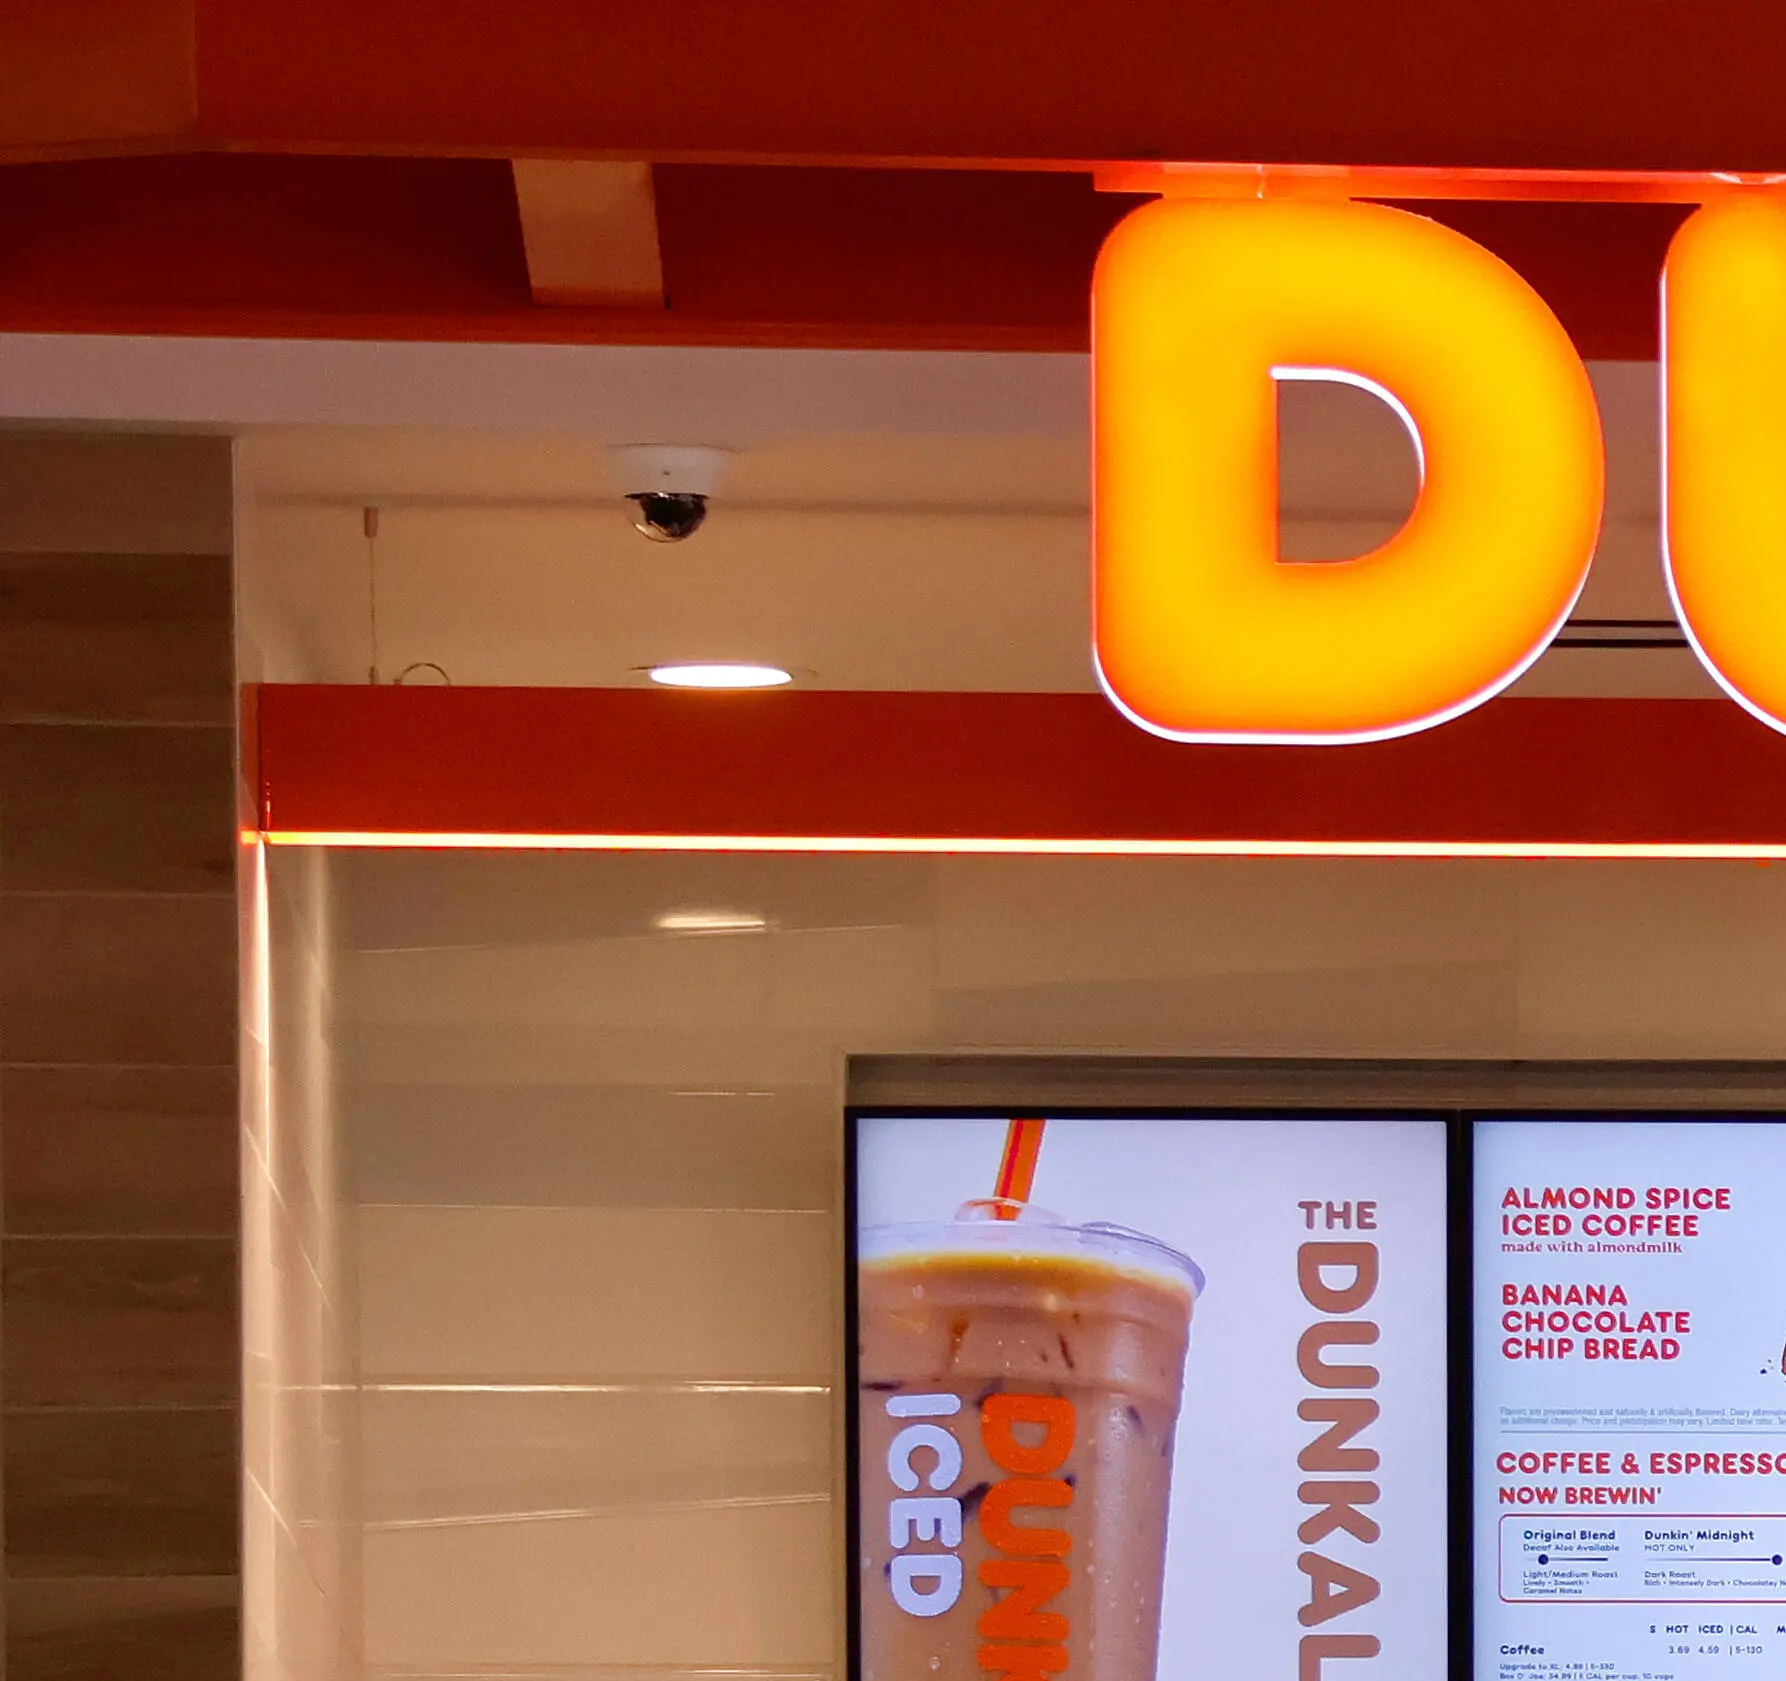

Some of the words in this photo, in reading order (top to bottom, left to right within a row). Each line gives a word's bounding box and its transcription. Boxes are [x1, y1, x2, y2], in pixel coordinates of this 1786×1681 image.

[1502, 1188, 1637, 1211] ALMOND
[1646, 1188, 1732, 1211] SPICE
[1298, 1201, 1379, 1231] THE
[1503, 1212, 1573, 1237] ICED
[1582, 1212, 1700, 1238] COFFEE
[1502, 1242, 1541, 1253] made
[1548, 1241, 1584, 1254] with
[1589, 1242, 1683, 1254] almondmilk
[1503, 1285, 1629, 1307] BANANA
[1502, 1308, 1691, 1334] CHOCOLATE
[1502, 1338, 1575, 1361] CHIP
[1585, 1339, 1681, 1361] BREAD
[1497, 1452, 1612, 1475] COFFEE
[1621, 1453, 1641, 1476] &
[884, 1389, 968, 1622] ICED
[1500, 1487, 1559, 1506] NOW
[1566, 1487, 1662, 1506] BREWIN'
[1524, 1530, 1577, 1544] Original
[1581, 1531, 1617, 1541] Blend
[1645, 1531, 1693, 1542] Dunkin'
[1697, 1531, 1755, 1544] Midnight
[1500, 1645, 1546, 1656] Coffee
